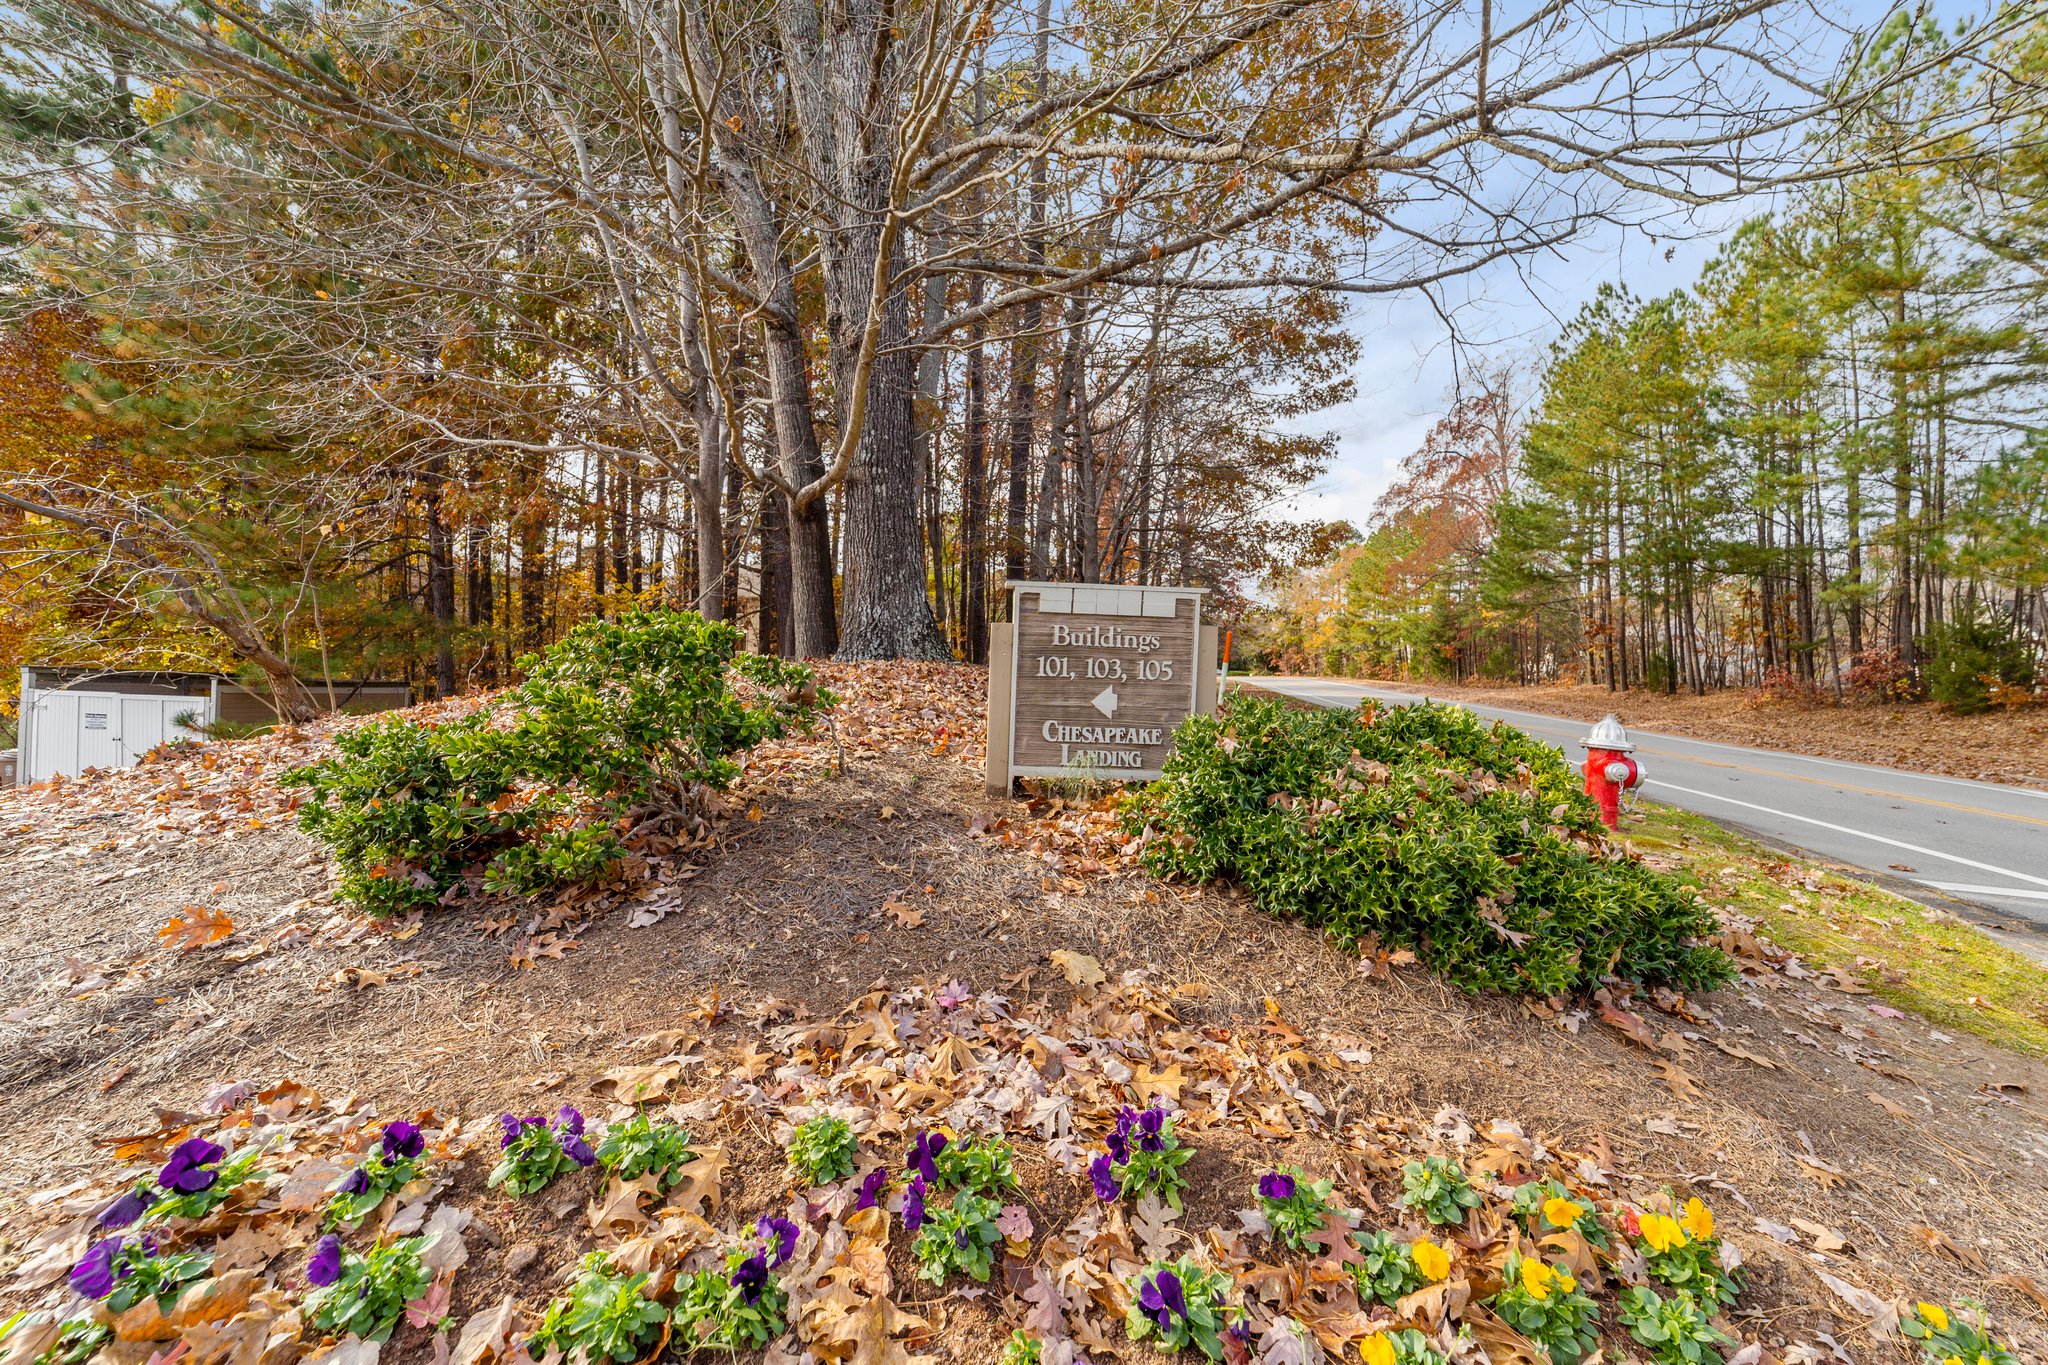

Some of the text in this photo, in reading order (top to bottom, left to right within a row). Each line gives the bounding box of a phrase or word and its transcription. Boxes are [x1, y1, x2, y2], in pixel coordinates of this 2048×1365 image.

[1052, 624, 1160, 653] Buildings
[1036, 656, 1173, 683] 101, 103, 105
[1042, 720, 1162, 745] CHESAPEAKE
[1060, 743, 1142, 768] LANDING
